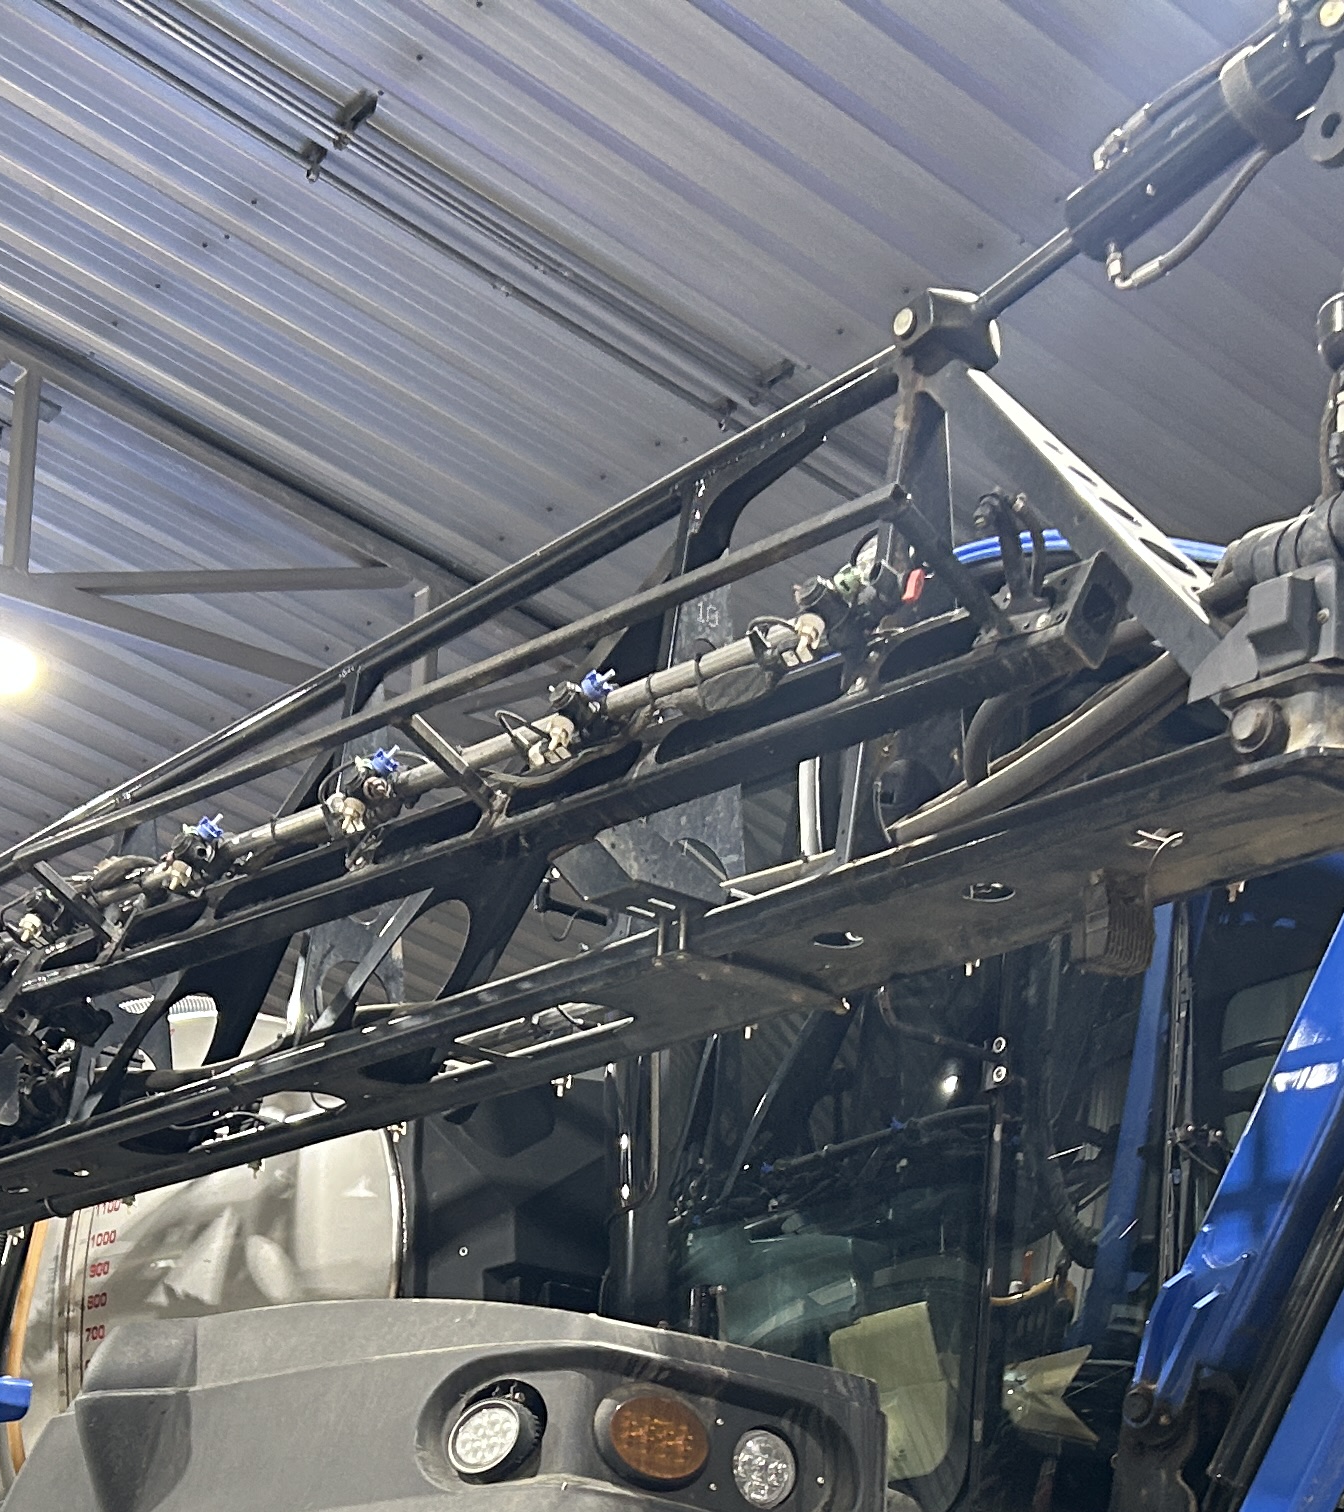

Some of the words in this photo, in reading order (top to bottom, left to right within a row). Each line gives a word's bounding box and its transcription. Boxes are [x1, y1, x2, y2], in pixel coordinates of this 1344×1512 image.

[90, 1229, 117, 1248] 1000
[89, 1260, 110, 1279] 900
[87, 1292, 108, 1310] 800
[85, 1324, 106, 1342] 700
